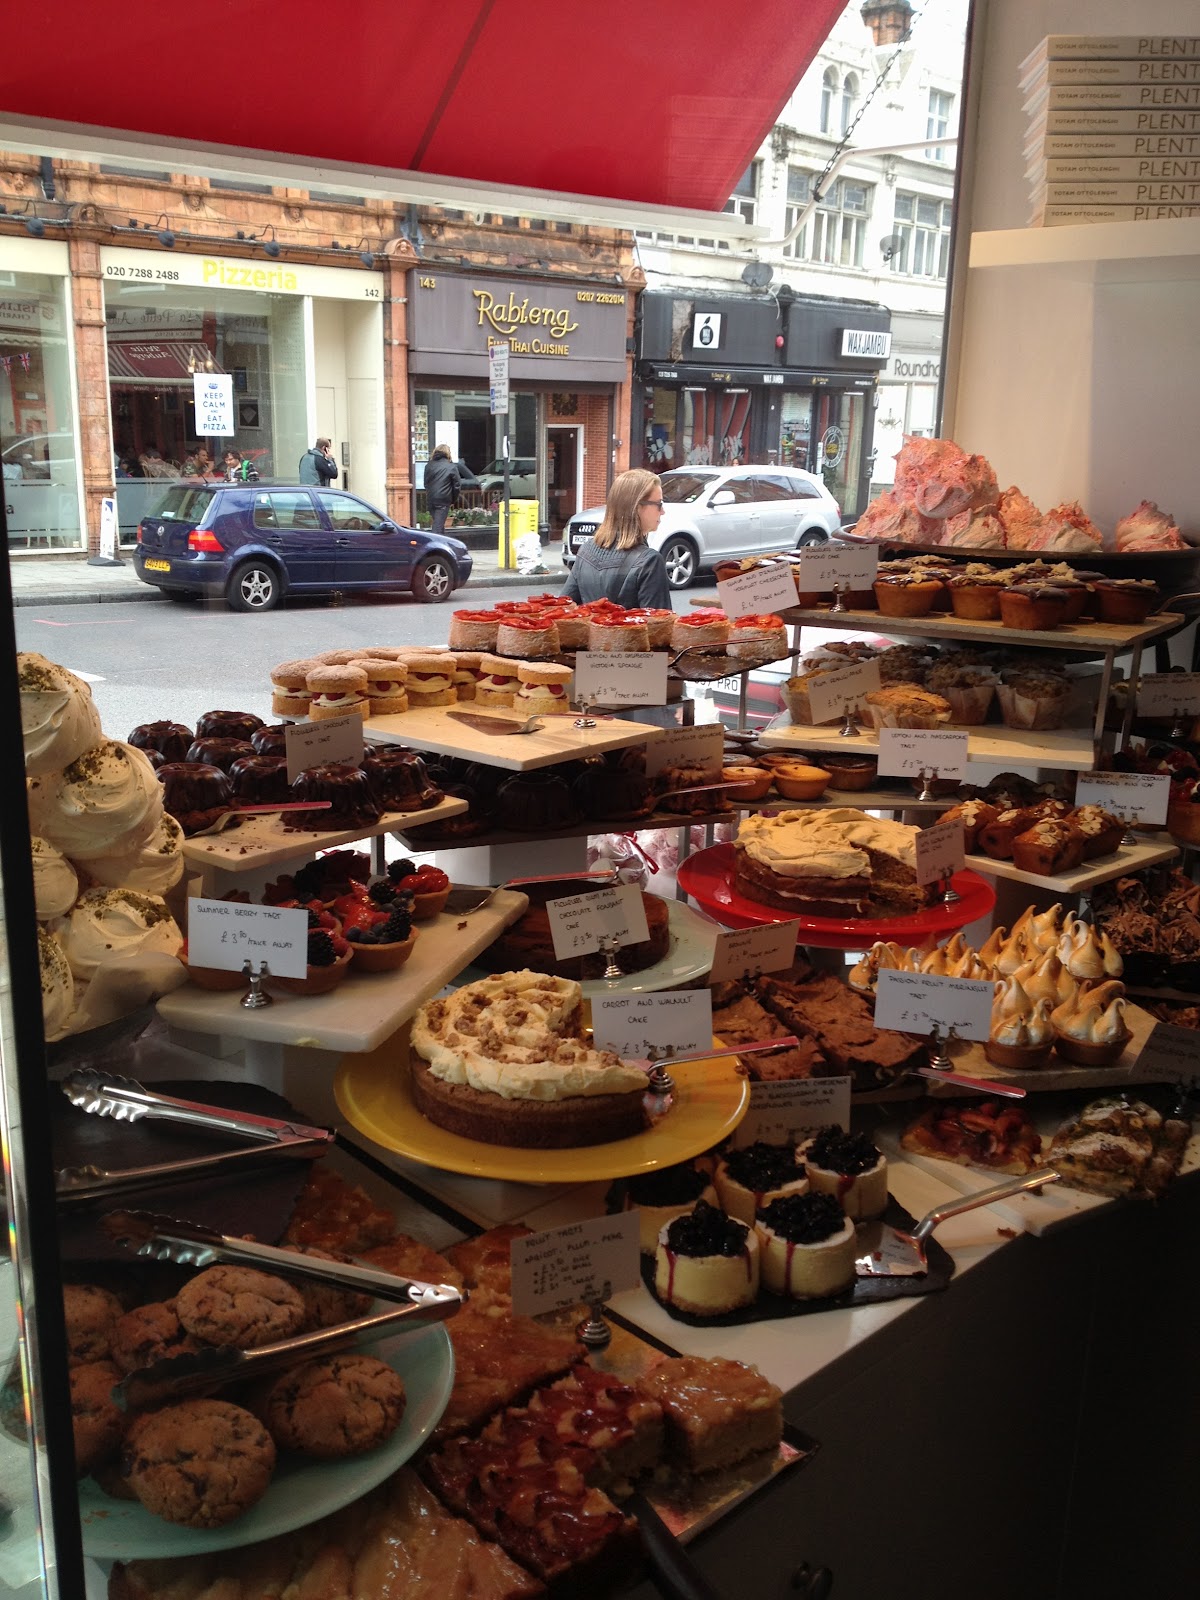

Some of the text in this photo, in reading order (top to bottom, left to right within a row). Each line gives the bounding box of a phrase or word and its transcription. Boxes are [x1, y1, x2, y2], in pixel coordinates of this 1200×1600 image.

[107, 266, 179, 280] 020 7288 2488
[203, 260, 297, 290] Pizzeria
[419, 277, 436, 289] 143
[365, 289, 379, 297] 142
[577, 292, 594, 301] 0207
[862, 333, 887, 355] JAMBU
[198, 905, 282, 920] SUMMER BERRY TART
[272, 941, 293, 949] AWAY
[602, 996, 693, 1009] CARROT AND WALNUT
[628, 1016, 648, 1024] CAKE
